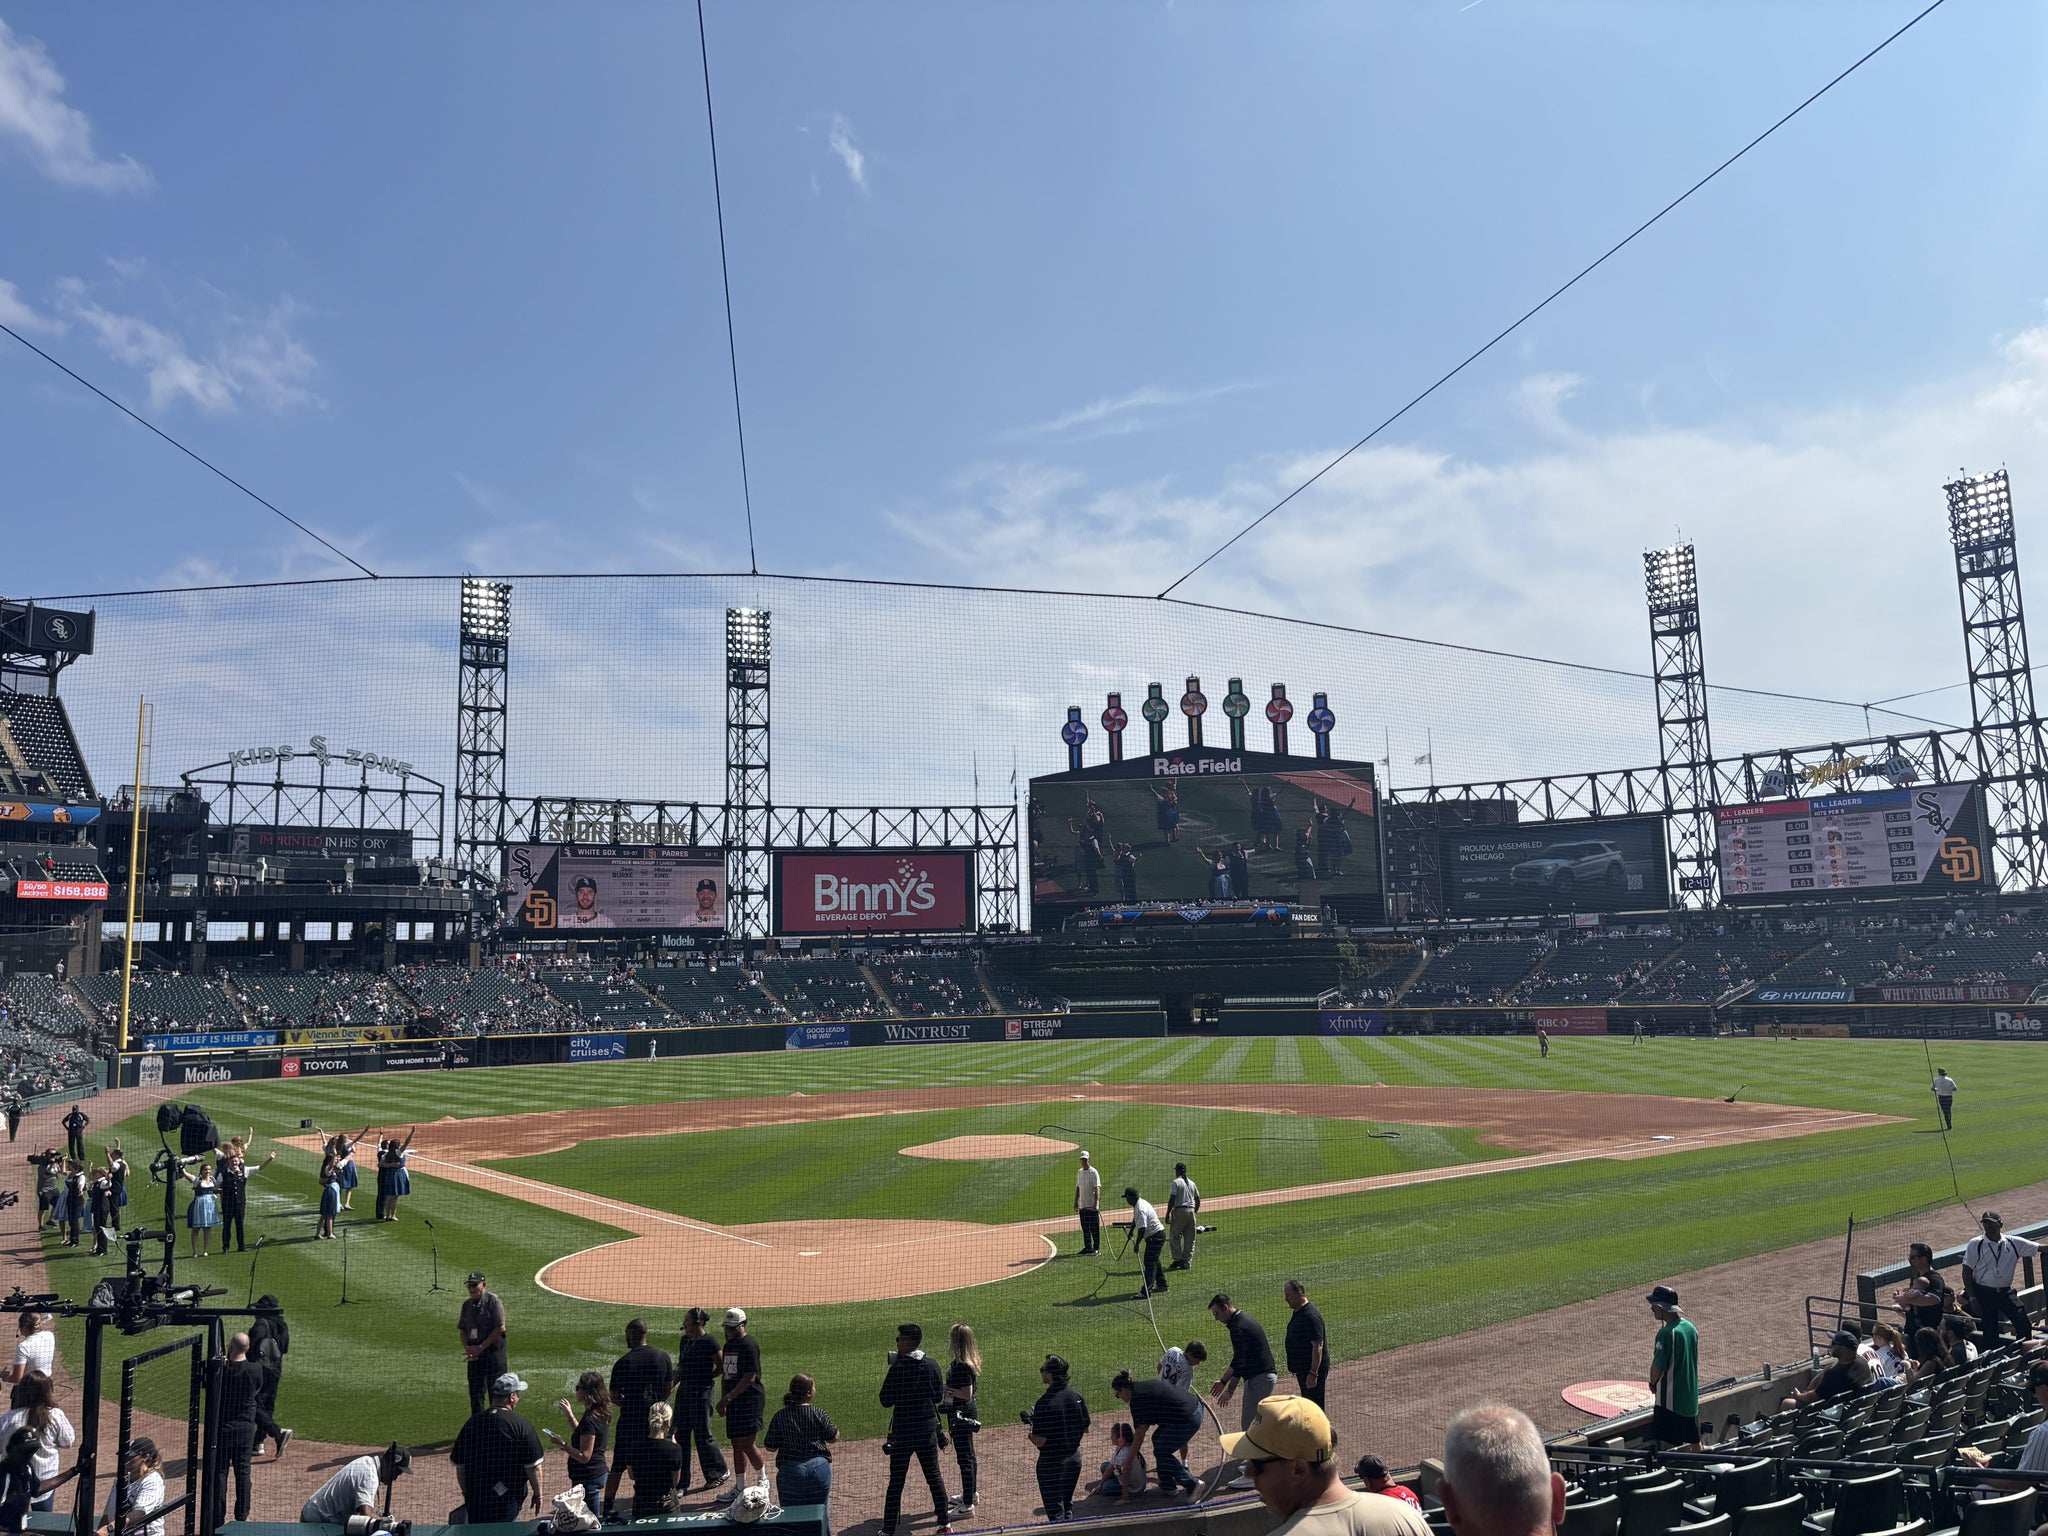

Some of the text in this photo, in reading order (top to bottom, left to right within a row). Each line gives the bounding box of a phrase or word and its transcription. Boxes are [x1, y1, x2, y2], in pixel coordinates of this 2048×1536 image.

[229, 745, 295, 768] KIDS
[345, 749, 412, 779] ZONE
[1154, 757, 1242, 776] Rate Field
[1887, 757, 1911, 773] Lite
[1801, 755, 1867, 788] Miller
[1764, 775, 1784, 788] Lite
[549, 801, 632, 816] CAESARS
[1829, 798, 1862, 807] LEADERS
[1733, 808, 1764, 817] LEADERS
[548, 819, 687, 843] SPORTSBOOK
[260, 834, 388, 849] IMRINTED IN HISORY
[1460, 841, 1543, 853] PROUDLY ASSEMBLED
[602, 849, 617, 857] SOX
[661, 850, 689, 858] PADRES
[1940, 836, 1981, 882] SD
[23, 883, 47, 891] 50/50
[526, 890, 556, 928] SD
[815, 912, 888, 922] BEVERAGE DEPOT
[662, 934, 695, 947] Modelo
[1782, 991, 1846, 1000] HYUNDAI
[1969, 985, 2010, 1000] MEATS
[1504, 1011, 1525, 1020] THE
[1994, 1011, 2042, 1031] Rate
[1023, 1019, 1062, 1029] STREAM
[1328, 1015, 1372, 1033] xfinity
[1537, 1018, 1559, 1028] CIBC
[306, 1028, 363, 1039] Vienna Beef
[1031, 1028, 1054, 1037] NOW
[173, 1033, 250, 1045] RELIEF IS HERE
[570, 1037, 591, 1049] city
[570, 1047, 610, 1057] cruises
[304, 1061, 349, 1071] TOYOTA
[185, 1066, 232, 1083] Modelo
